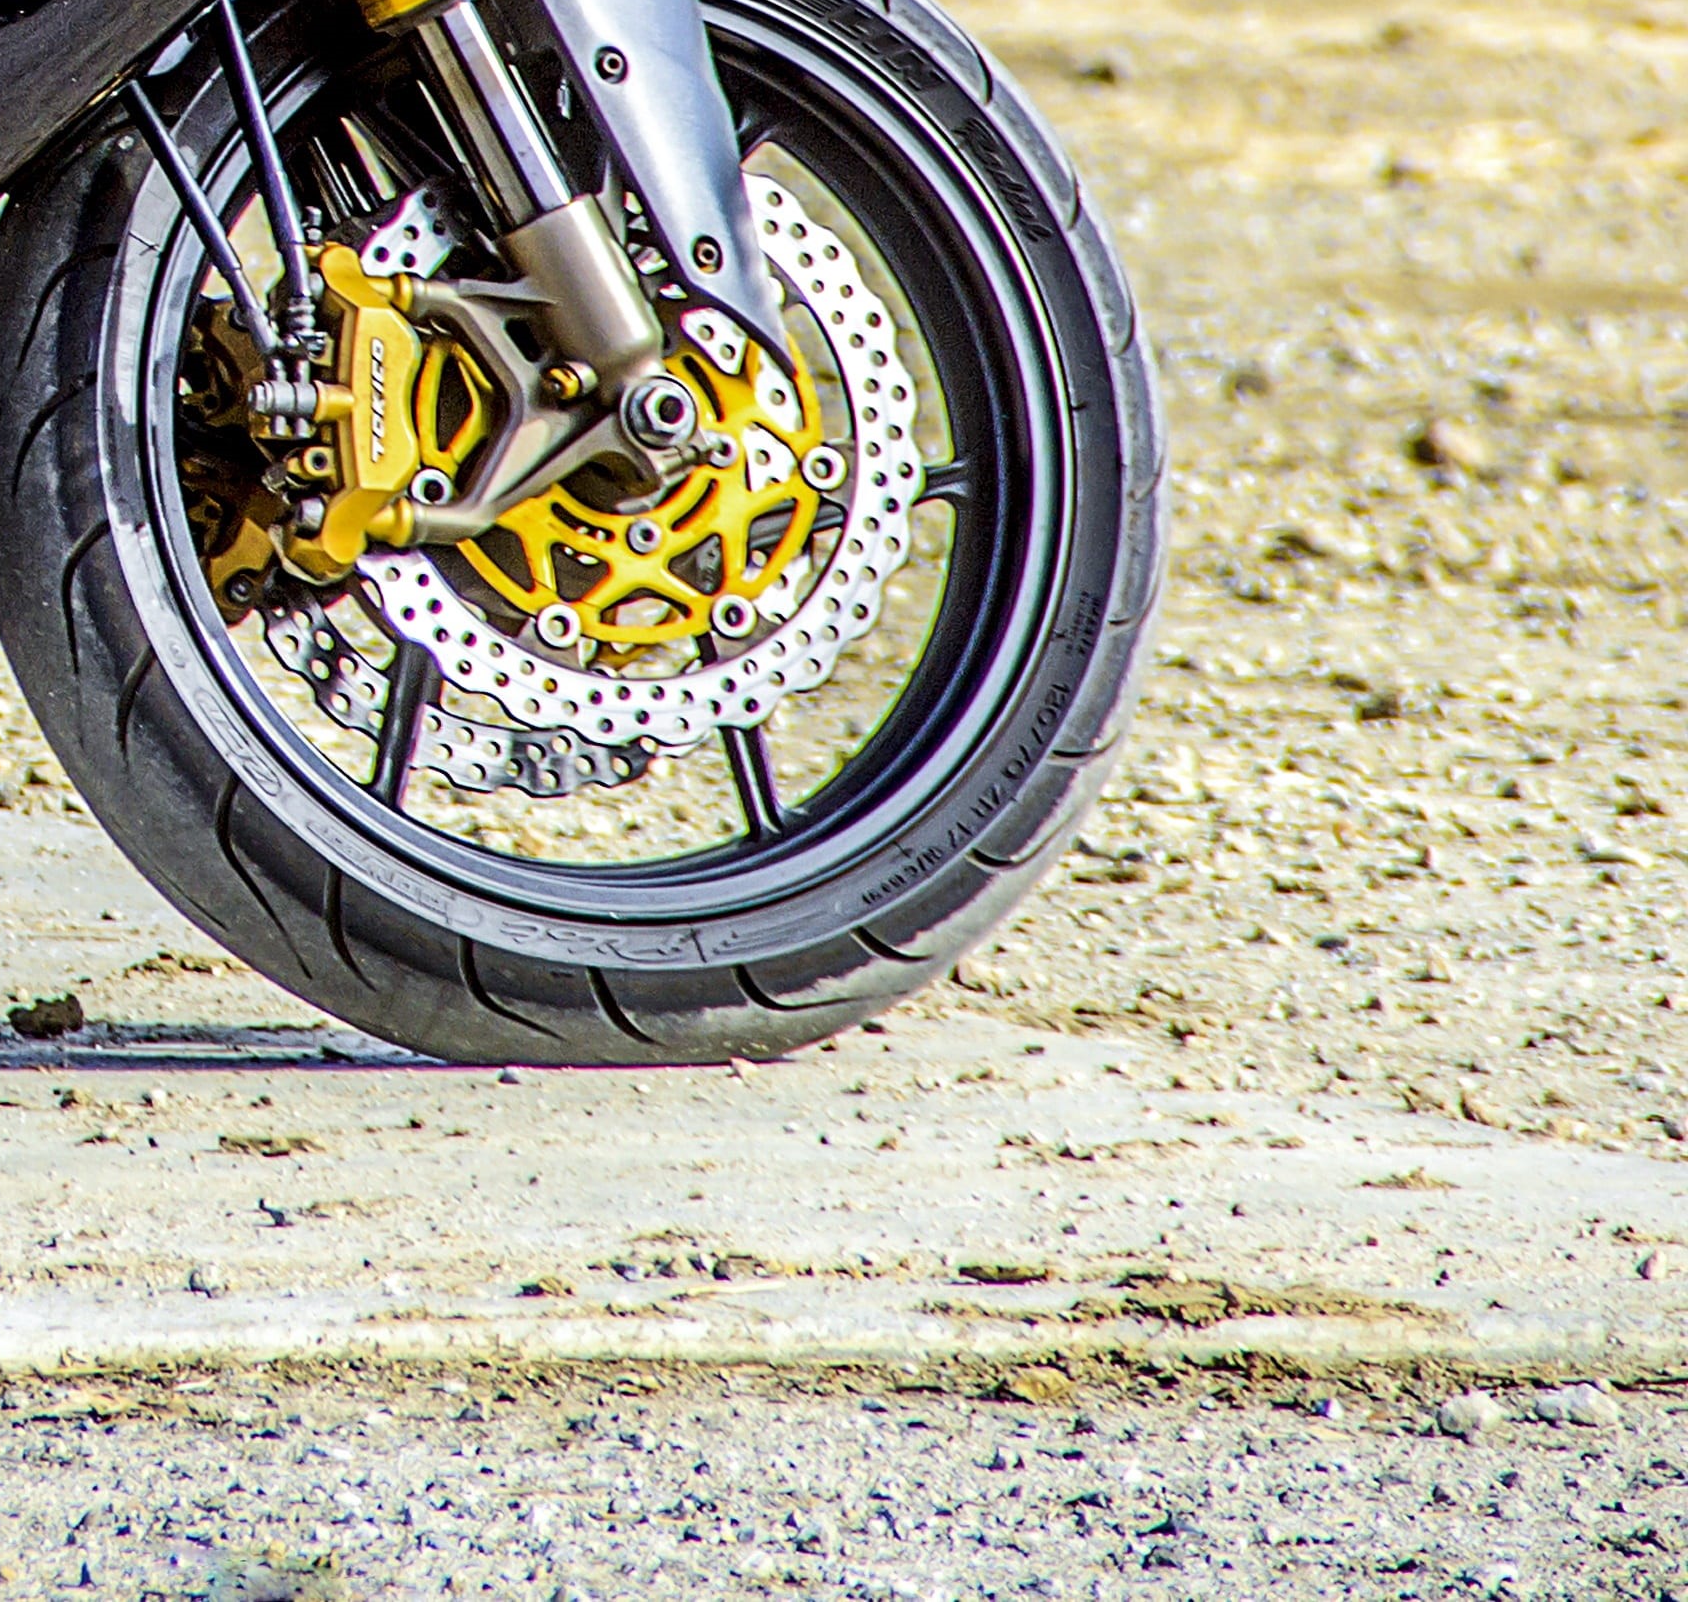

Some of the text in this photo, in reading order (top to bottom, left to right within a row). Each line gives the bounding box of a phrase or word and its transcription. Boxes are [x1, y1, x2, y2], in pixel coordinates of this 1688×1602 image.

[954, 116, 1053, 243] Radial
[371, 337, 385, 463] TOKICO
[1002, 682, 1071, 781] 120/70
